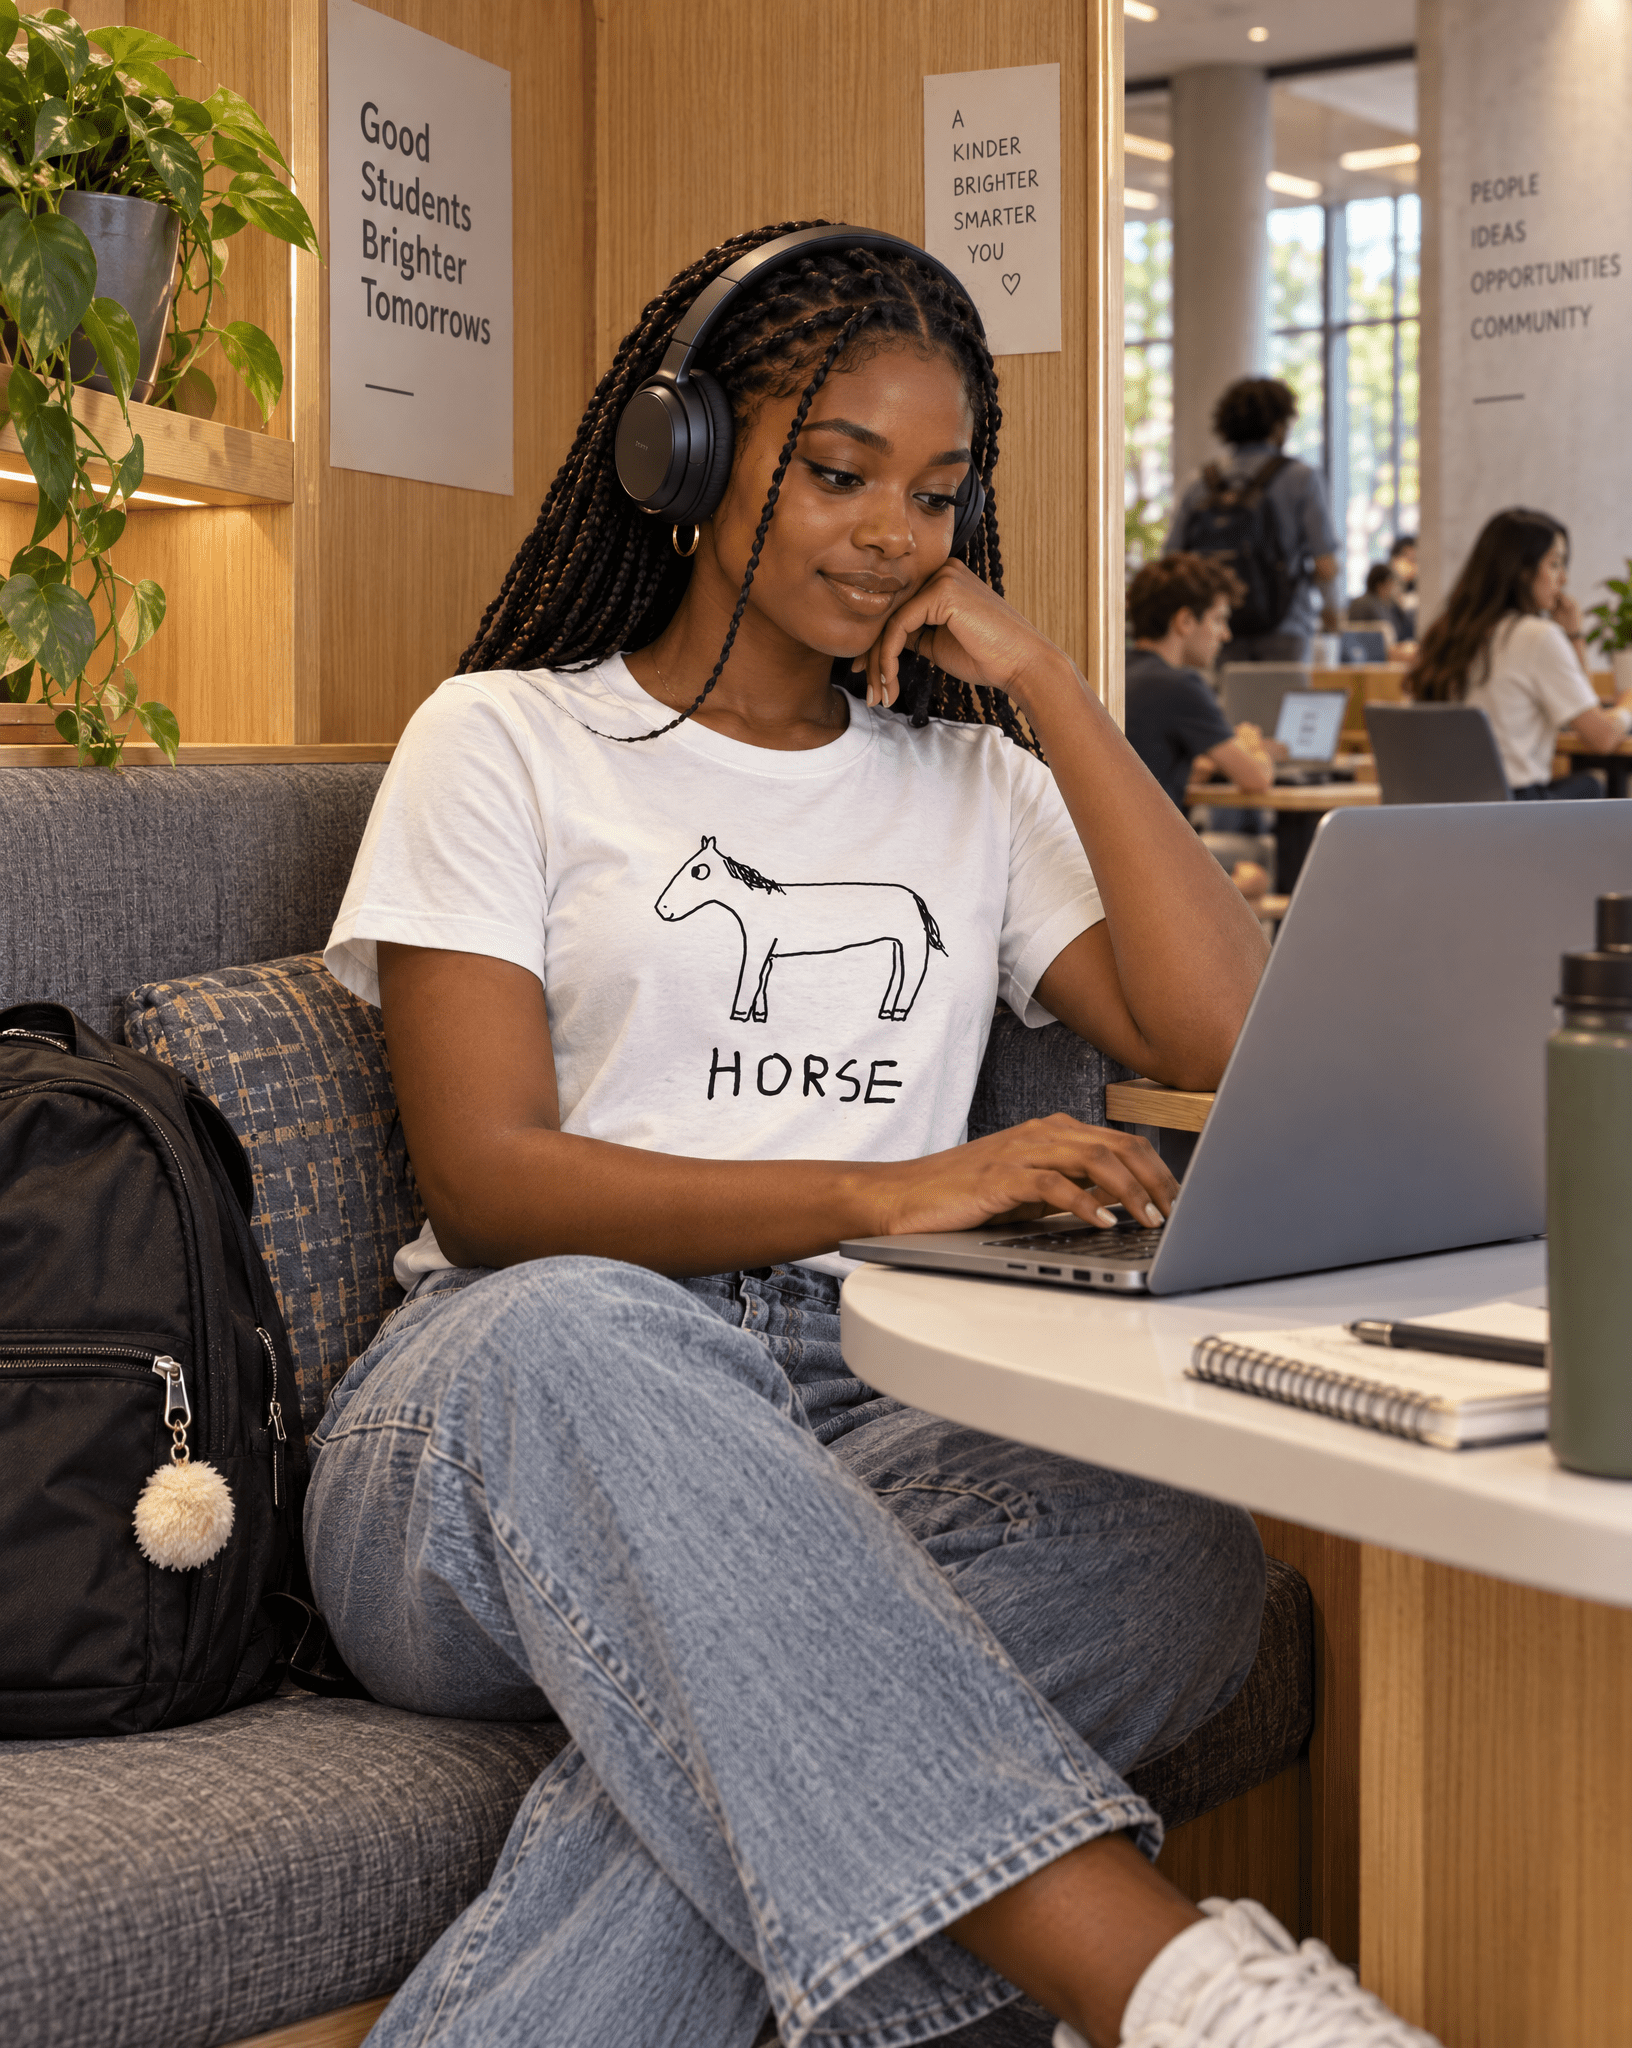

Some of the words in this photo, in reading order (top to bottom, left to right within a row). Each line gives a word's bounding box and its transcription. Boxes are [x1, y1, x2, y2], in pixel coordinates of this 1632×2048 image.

[360, 101, 430, 164] Good
[951, 109, 965, 130] A
[953, 136, 1022, 163] KINDER
[360, 160, 472, 233] Students
[953, 168, 1040, 197] BRIGHTER
[1470, 172, 1540, 205] PEOPLE
[953, 204, 1037, 231] SMARTER
[1470, 219, 1527, 250] IDEAS
[362, 218, 467, 285] Brighter
[967, 241, 1004, 264] YOU
[1469, 252, 1622, 296] OPPORTUNITIES
[360, 275, 491, 346] Tomorrows
[1469, 304, 1593, 342] COMMUNITY
[707, 1047, 903, 1104] HORSE
